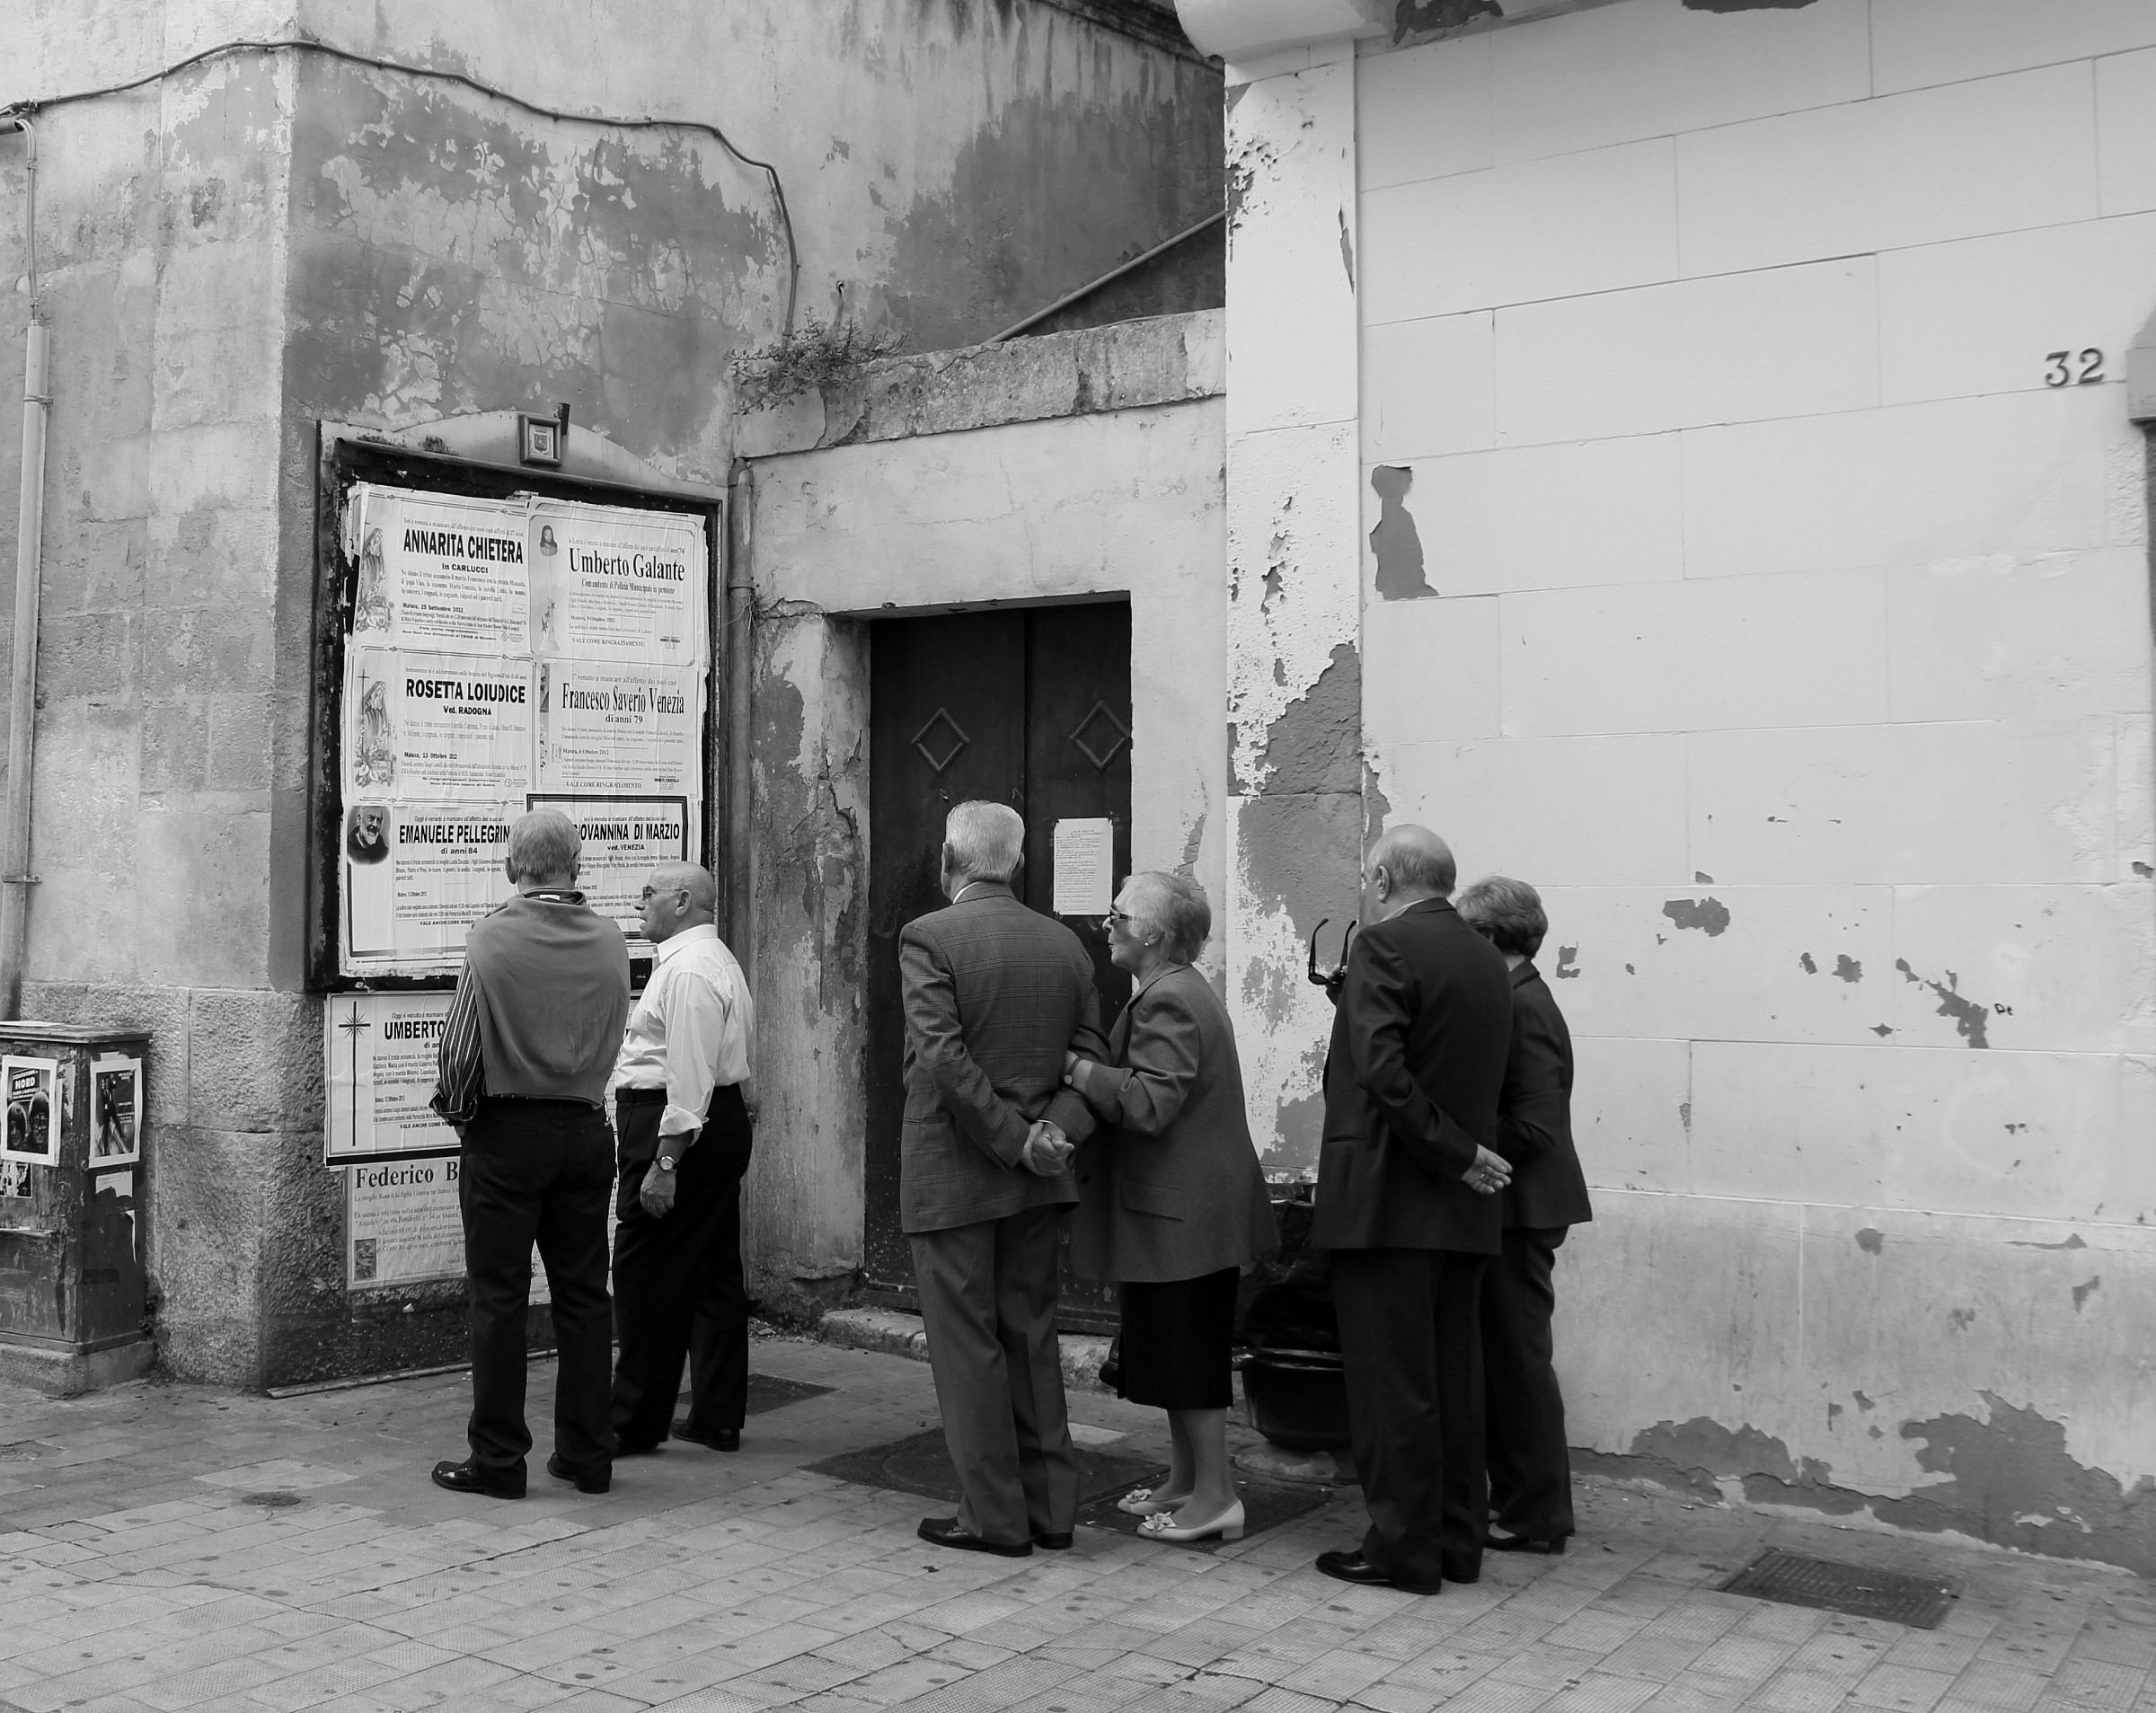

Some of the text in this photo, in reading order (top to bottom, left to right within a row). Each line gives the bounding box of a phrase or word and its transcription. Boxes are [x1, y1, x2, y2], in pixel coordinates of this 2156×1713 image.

[2046, 348, 2104, 387] 32
[403, 528, 524, 564] ANNARITA CHIETERA
[442, 562, 489, 574] In CARLUCCI
[570, 548, 685, 581] Umberto Galante
[429, 605, 451, 613] Settembre
[406, 679, 526, 704] ROSETTA LOIUDICE
[562, 683, 685, 715] Francesco Saverio Venezia
[458, 706, 492, 716] RADOGNA
[614, 715, 632, 724] anni
[634, 716, 643, 724] 79
[399, 825, 455, 843] EMANUELE
[634, 824, 643, 840] DI
[647, 823, 680, 840] MARZIO
[15, 1077, 36, 1090] NORD
[355, 1164, 434, 1189] Federico
